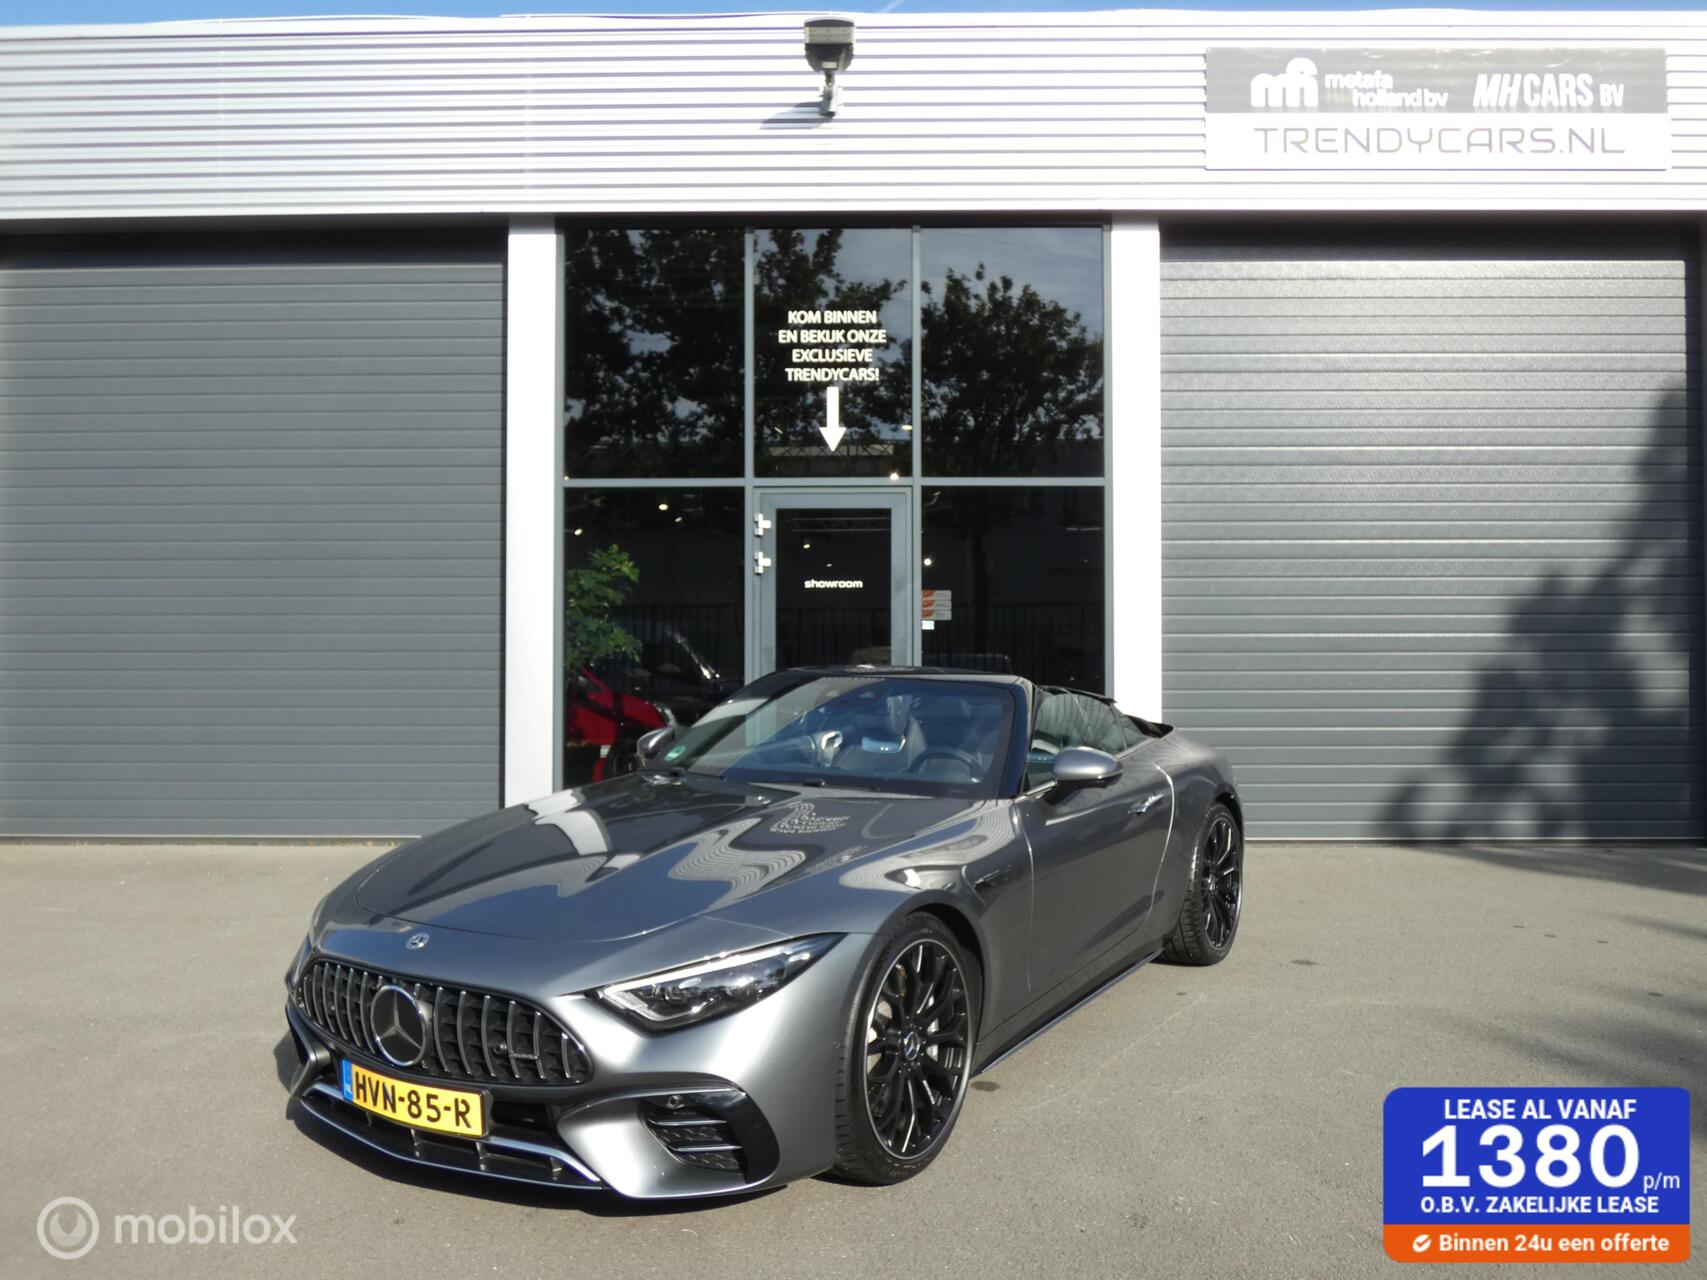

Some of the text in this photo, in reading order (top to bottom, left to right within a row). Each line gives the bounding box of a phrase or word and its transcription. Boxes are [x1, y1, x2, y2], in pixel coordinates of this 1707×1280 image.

[1352, 89, 1449, 107] holland bv
[1600, 84, 1625, 107] BV
[1253, 127, 1626, 154] TRENDYCARS.NL
[787, 310, 877, 324] KOM BINNEN
[778, 329, 887, 344] EN BEKIJK ONZE
[791, 348, 873, 363] EXCLUSIEVE
[785, 368, 880, 382] TRENDYCARS!
[804, 578, 864, 589] showroom
[354, 1071, 472, 1129] HVN-85-R
